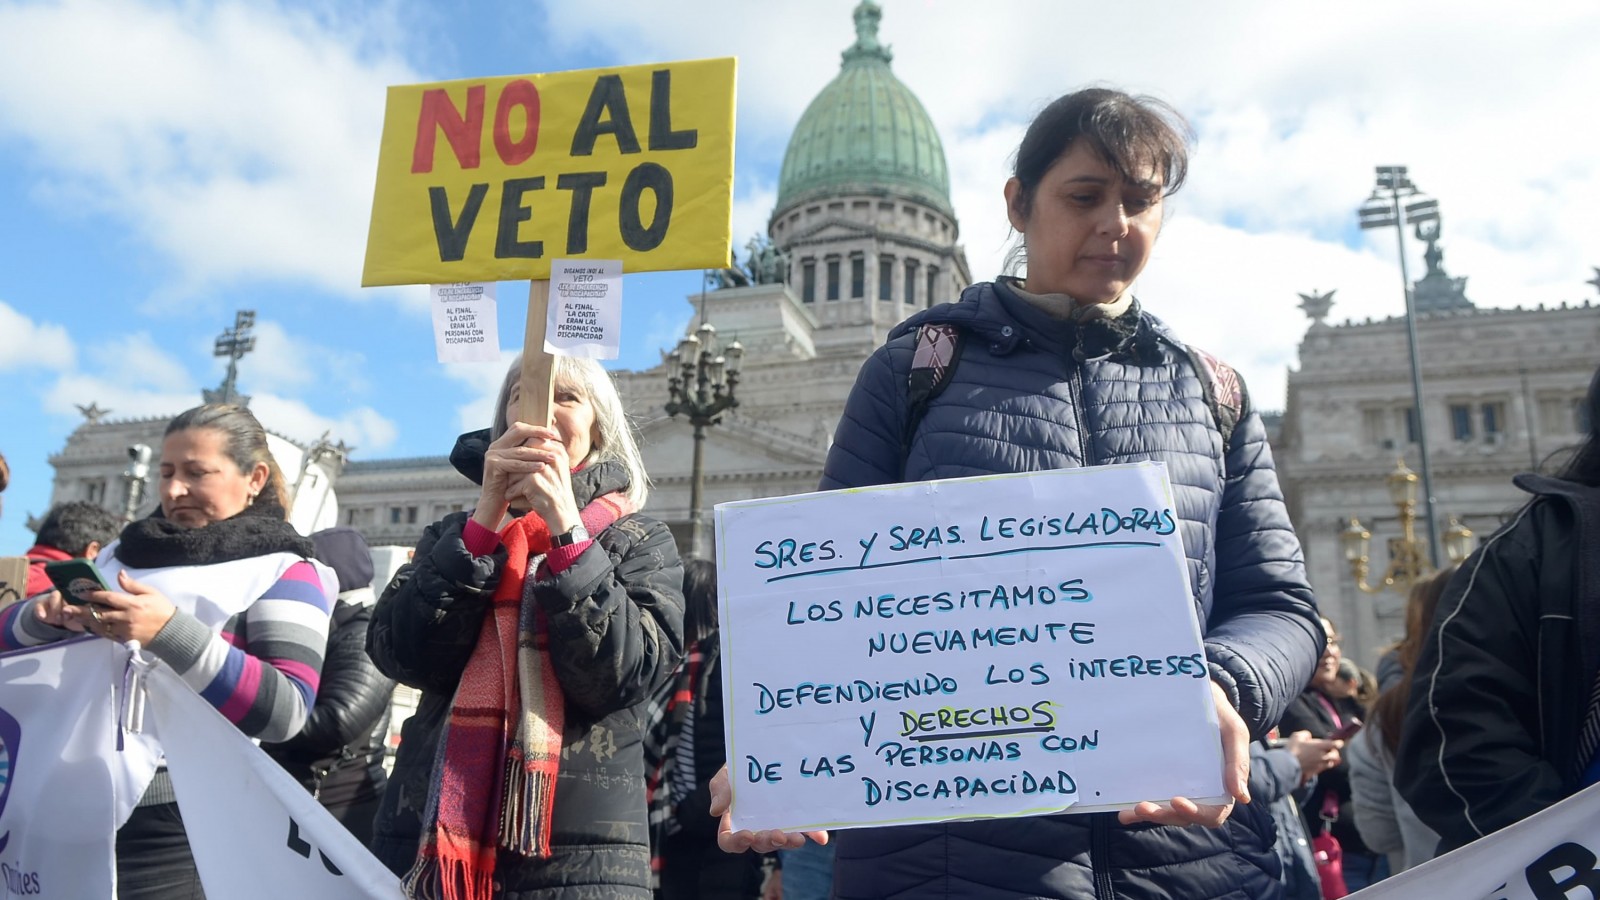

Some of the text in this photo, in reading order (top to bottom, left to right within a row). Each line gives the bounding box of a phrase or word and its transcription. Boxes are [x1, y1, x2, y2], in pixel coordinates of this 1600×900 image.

[411, 69, 698, 173] NO AL
[428, 162, 674, 262] VETO
[445, 336, 485, 344] DISCAPACIDAD
[557, 331, 603, 340] DISCAPACIDAD
[558, 324, 588, 332] PERSONAS
[754, 538, 843, 569] SRES.
[859, 532, 879, 569] Y
[889, 524, 965, 551] SRAS.
[786, 600, 843, 625] LOS
[868, 622, 1095, 658] NUEVAMENTE
[985, 663, 1050, 685] LOS
[859, 700, 1056, 747] Y DERECHOS
[746, 729, 1098, 784] DE LAS PERSONAS CON
